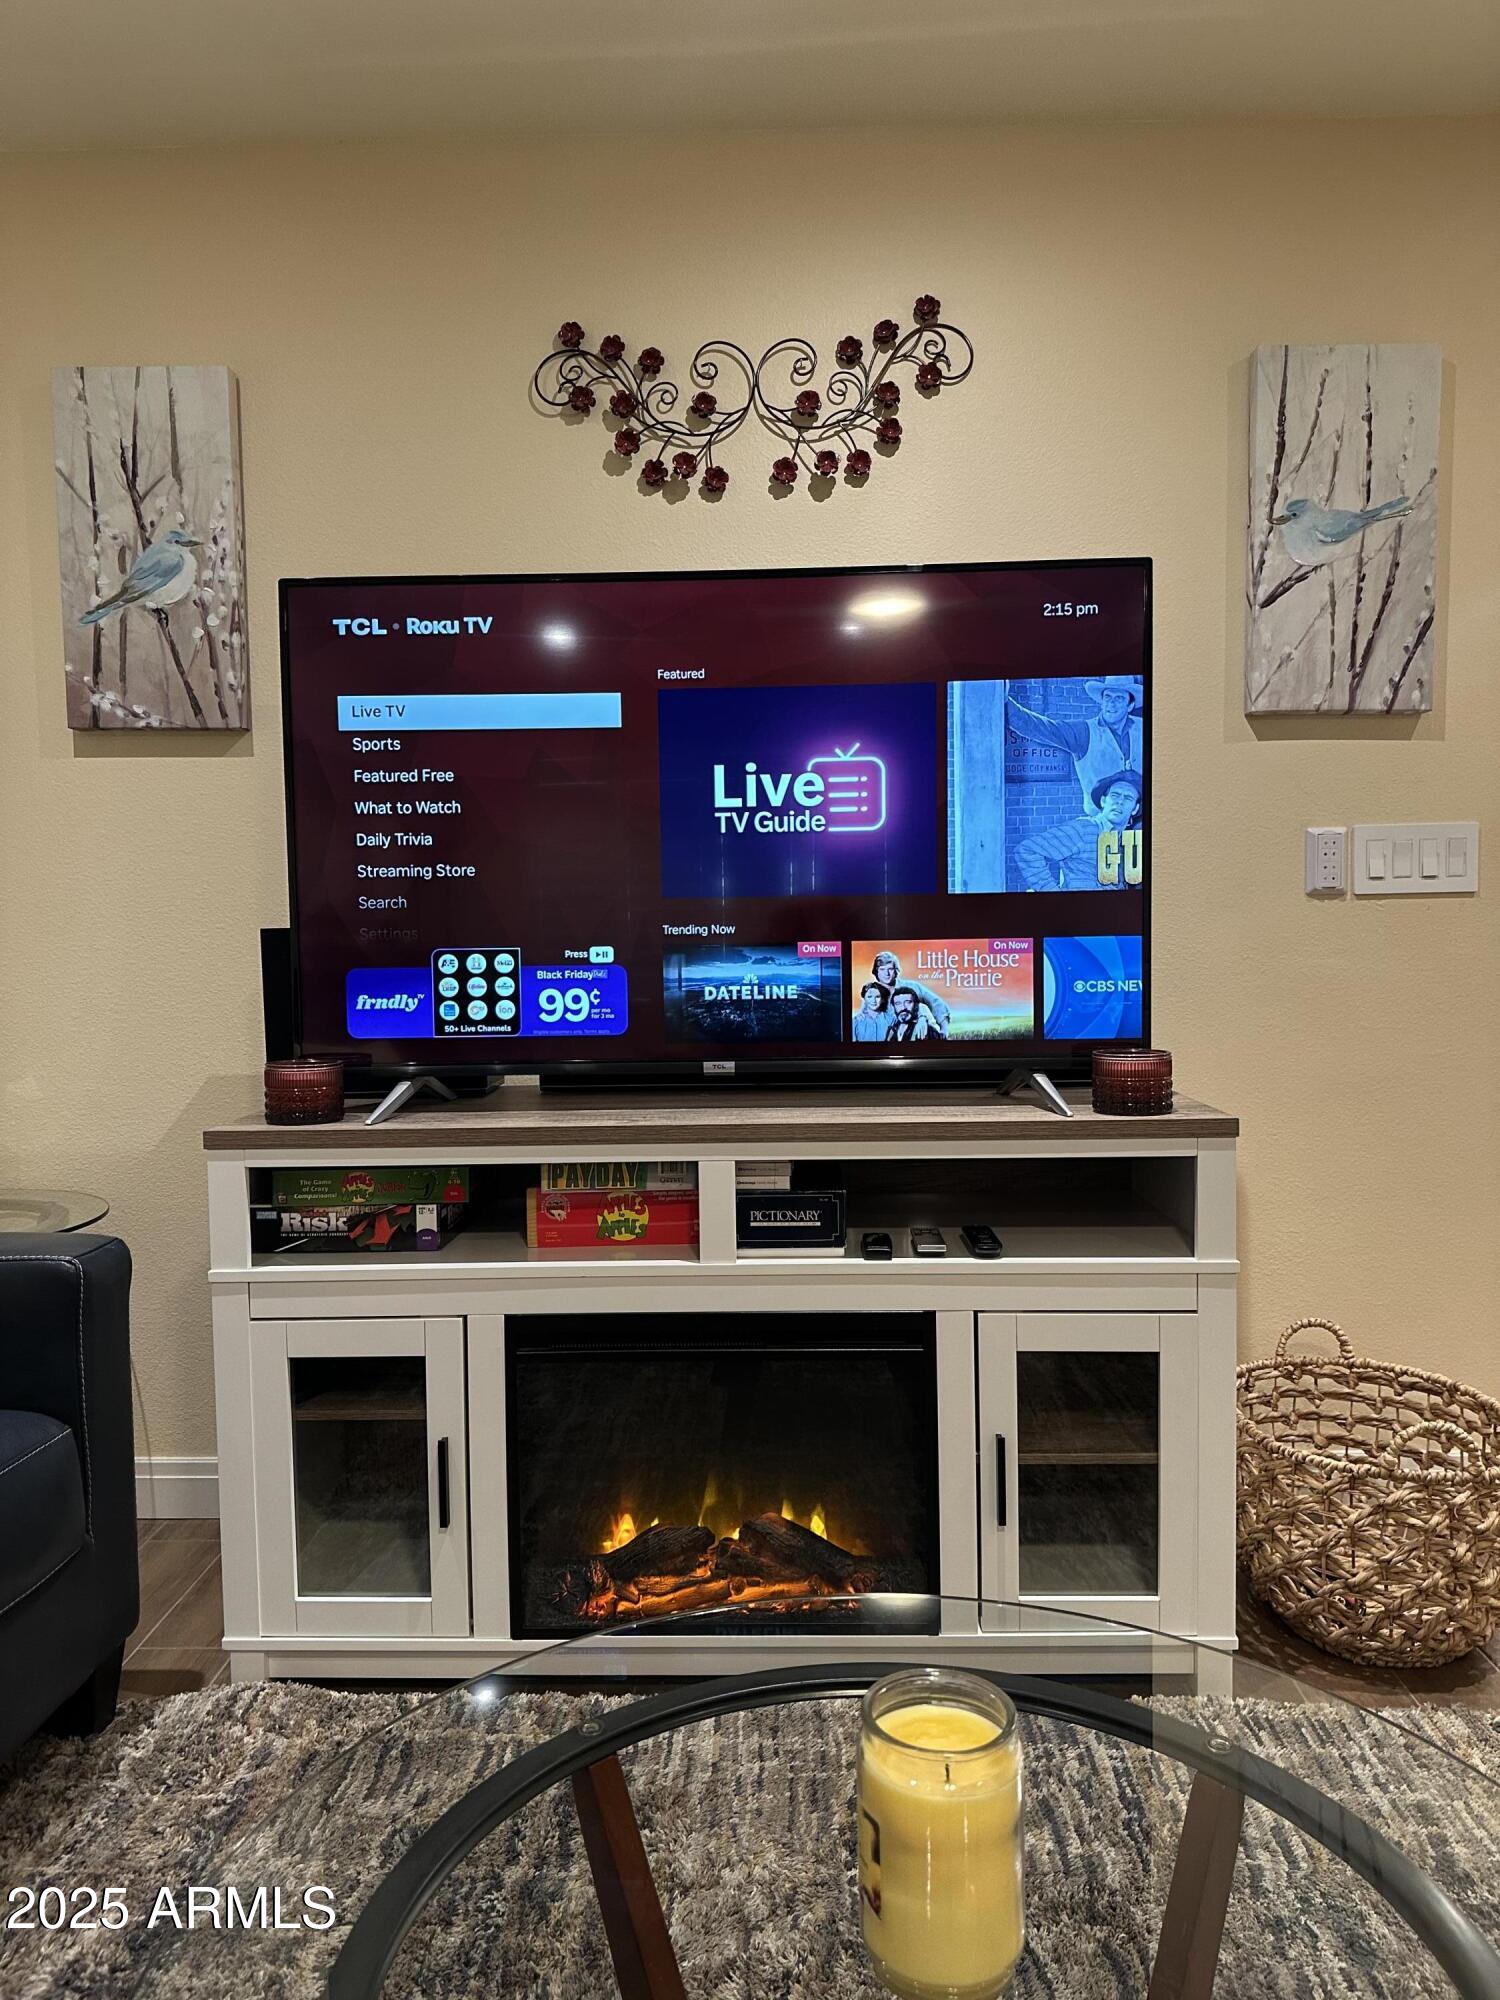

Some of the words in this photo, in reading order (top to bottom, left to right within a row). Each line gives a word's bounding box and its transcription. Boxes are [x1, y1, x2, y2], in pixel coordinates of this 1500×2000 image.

[1043, 603, 1072, 616] 2:15
[1076, 605, 1099, 618] pm
[332, 619, 387, 636] TCL
[463, 617, 493, 634] TV
[657, 668, 705, 681] Featured
[351, 704, 382, 718] Live
[385, 704, 406, 718] TV
[352, 737, 401, 753] Sports
[1013, 748, 1058, 758] OFFICE
[354, 769, 418, 783] Featured
[422, 769, 454, 782] Free
[713, 762, 826, 808] Live
[354, 801, 393, 815] What
[396, 802, 413, 815] to
[415, 800, 461, 814] Watch
[714, 812, 750, 834] TV
[754, 810, 827, 833] Guide
[356, 833, 391, 849] Daily
[394, 832, 433, 847] Trivia
[1097, 829, 1143, 885] GU
[356, 864, 433, 880] Streaming
[436, 863, 475, 878] Store
[358, 896, 407, 910] Search
[359, 927, 419, 942] Settings
[662, 924, 708, 938] Trending
[711, 923, 736, 935] Now
[802, 943, 816, 953] On
[817, 943, 837, 953] Now
[993, 941, 1007, 950] On
[1008, 940, 1029, 950] Now
[564, 950, 588, 959] Press
[917, 949, 958, 969] Little
[963, 949, 1019, 968] House
[536, 970, 562, 980] Black
[564, 969, 593, 981] Friday
[918, 972, 929, 980] on
[930, 970, 944, 980] the
[946, 969, 1002, 988] Prairie
[703, 983, 799, 1001] DATELINE
[1086, 980, 1115, 993] CBS
[356, 994, 418, 1013] frndly
[444, 1025, 459, 1033] 50+
[477, 1024, 511, 1032] Channels
[299, 1178, 313, 1186] The
[313, 1178, 332, 1186] Game
[750, 1210, 820, 1222] PICTIONARY
